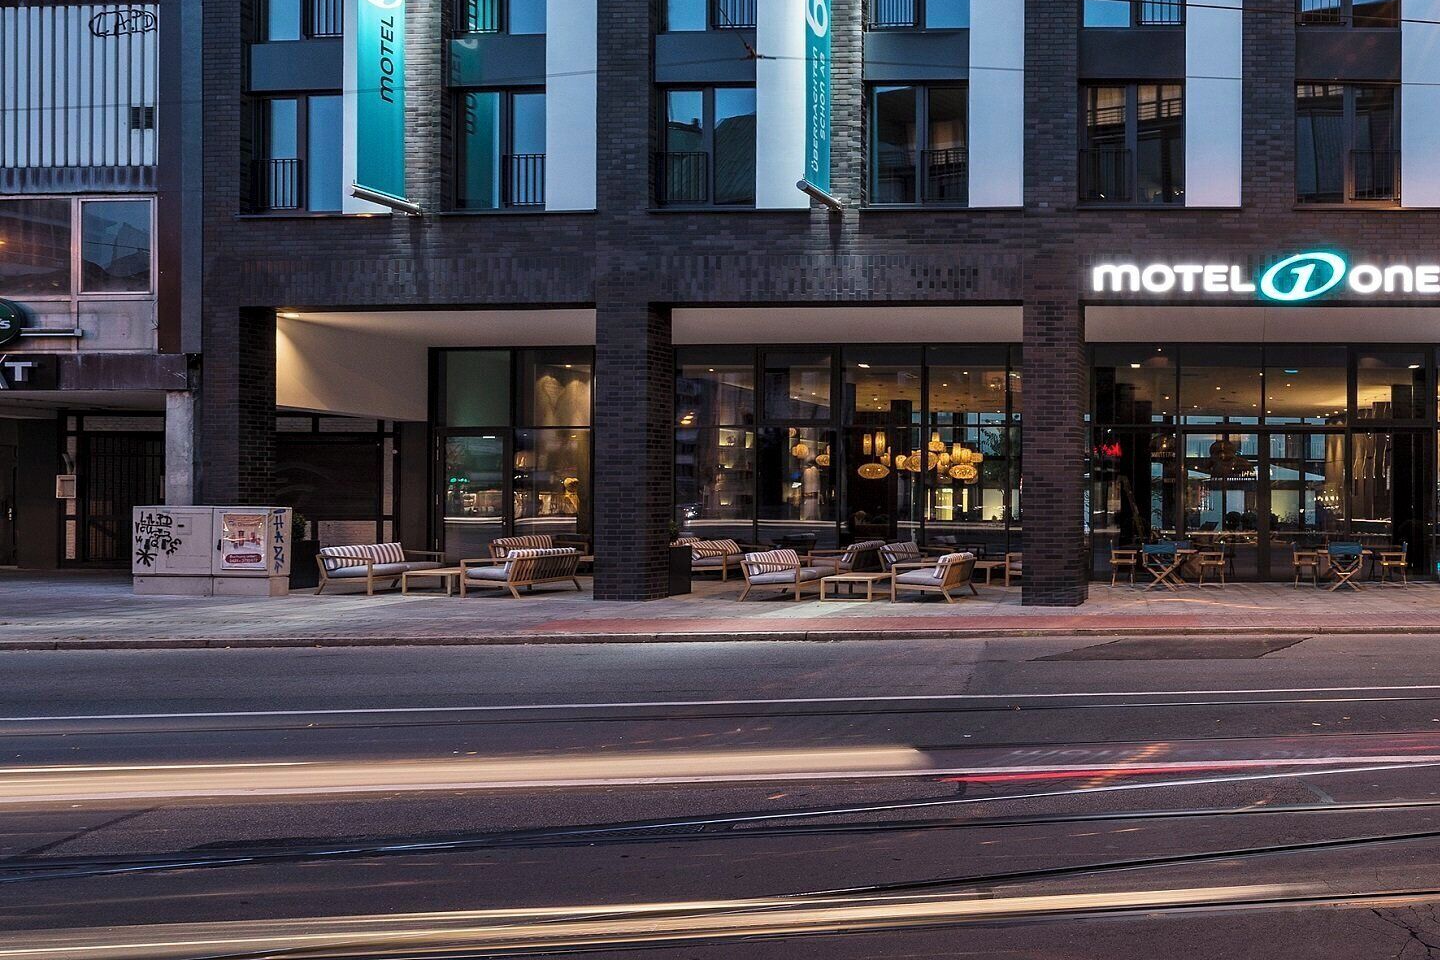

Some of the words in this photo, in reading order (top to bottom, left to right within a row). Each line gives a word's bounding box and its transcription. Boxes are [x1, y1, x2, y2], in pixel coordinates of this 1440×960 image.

[380, 15, 395, 104] MOTEL
[819, 52, 827, 77] AB
[1093, 264, 1255, 292] MOTEL
[1349, 265, 1440, 292] ONE
